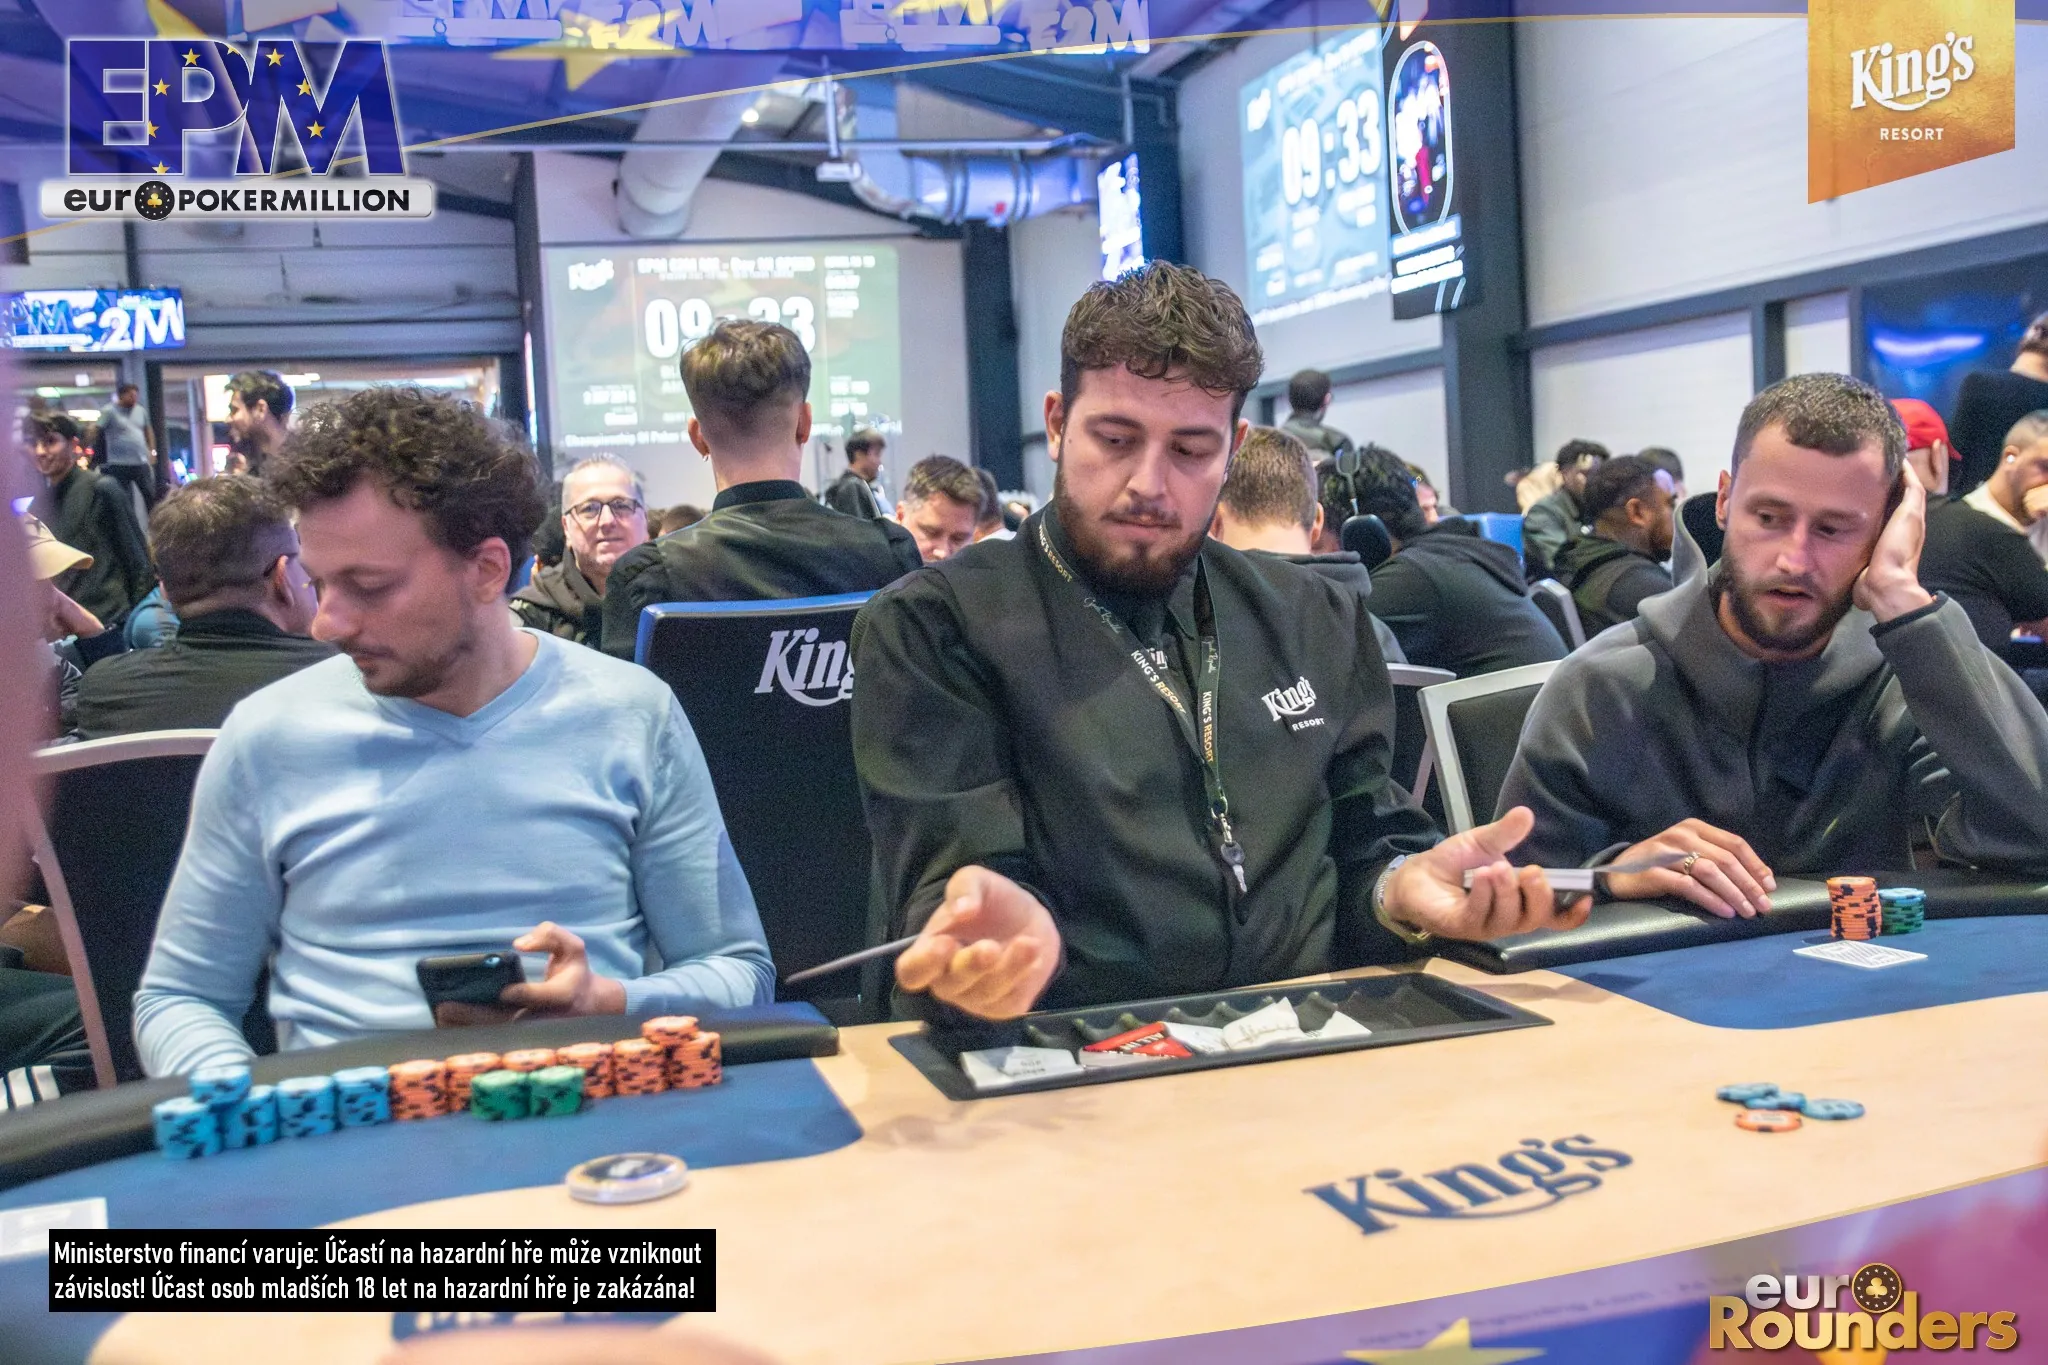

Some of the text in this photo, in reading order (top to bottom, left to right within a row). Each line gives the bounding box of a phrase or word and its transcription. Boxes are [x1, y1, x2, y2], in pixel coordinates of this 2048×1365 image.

[1282, 89, 1382, 206] 09:33
[645, 296, 816, 358] 093
[754, 627, 855, 707] Kin
[1131, 650, 1187, 714] KING'S RESORT
[1261, 676, 1317, 722] King's
[1202, 691, 1214, 762] KING'S RESORT
[1292, 718, 1325, 731] RESORT
[1301, 1134, 1634, 1236] King's
